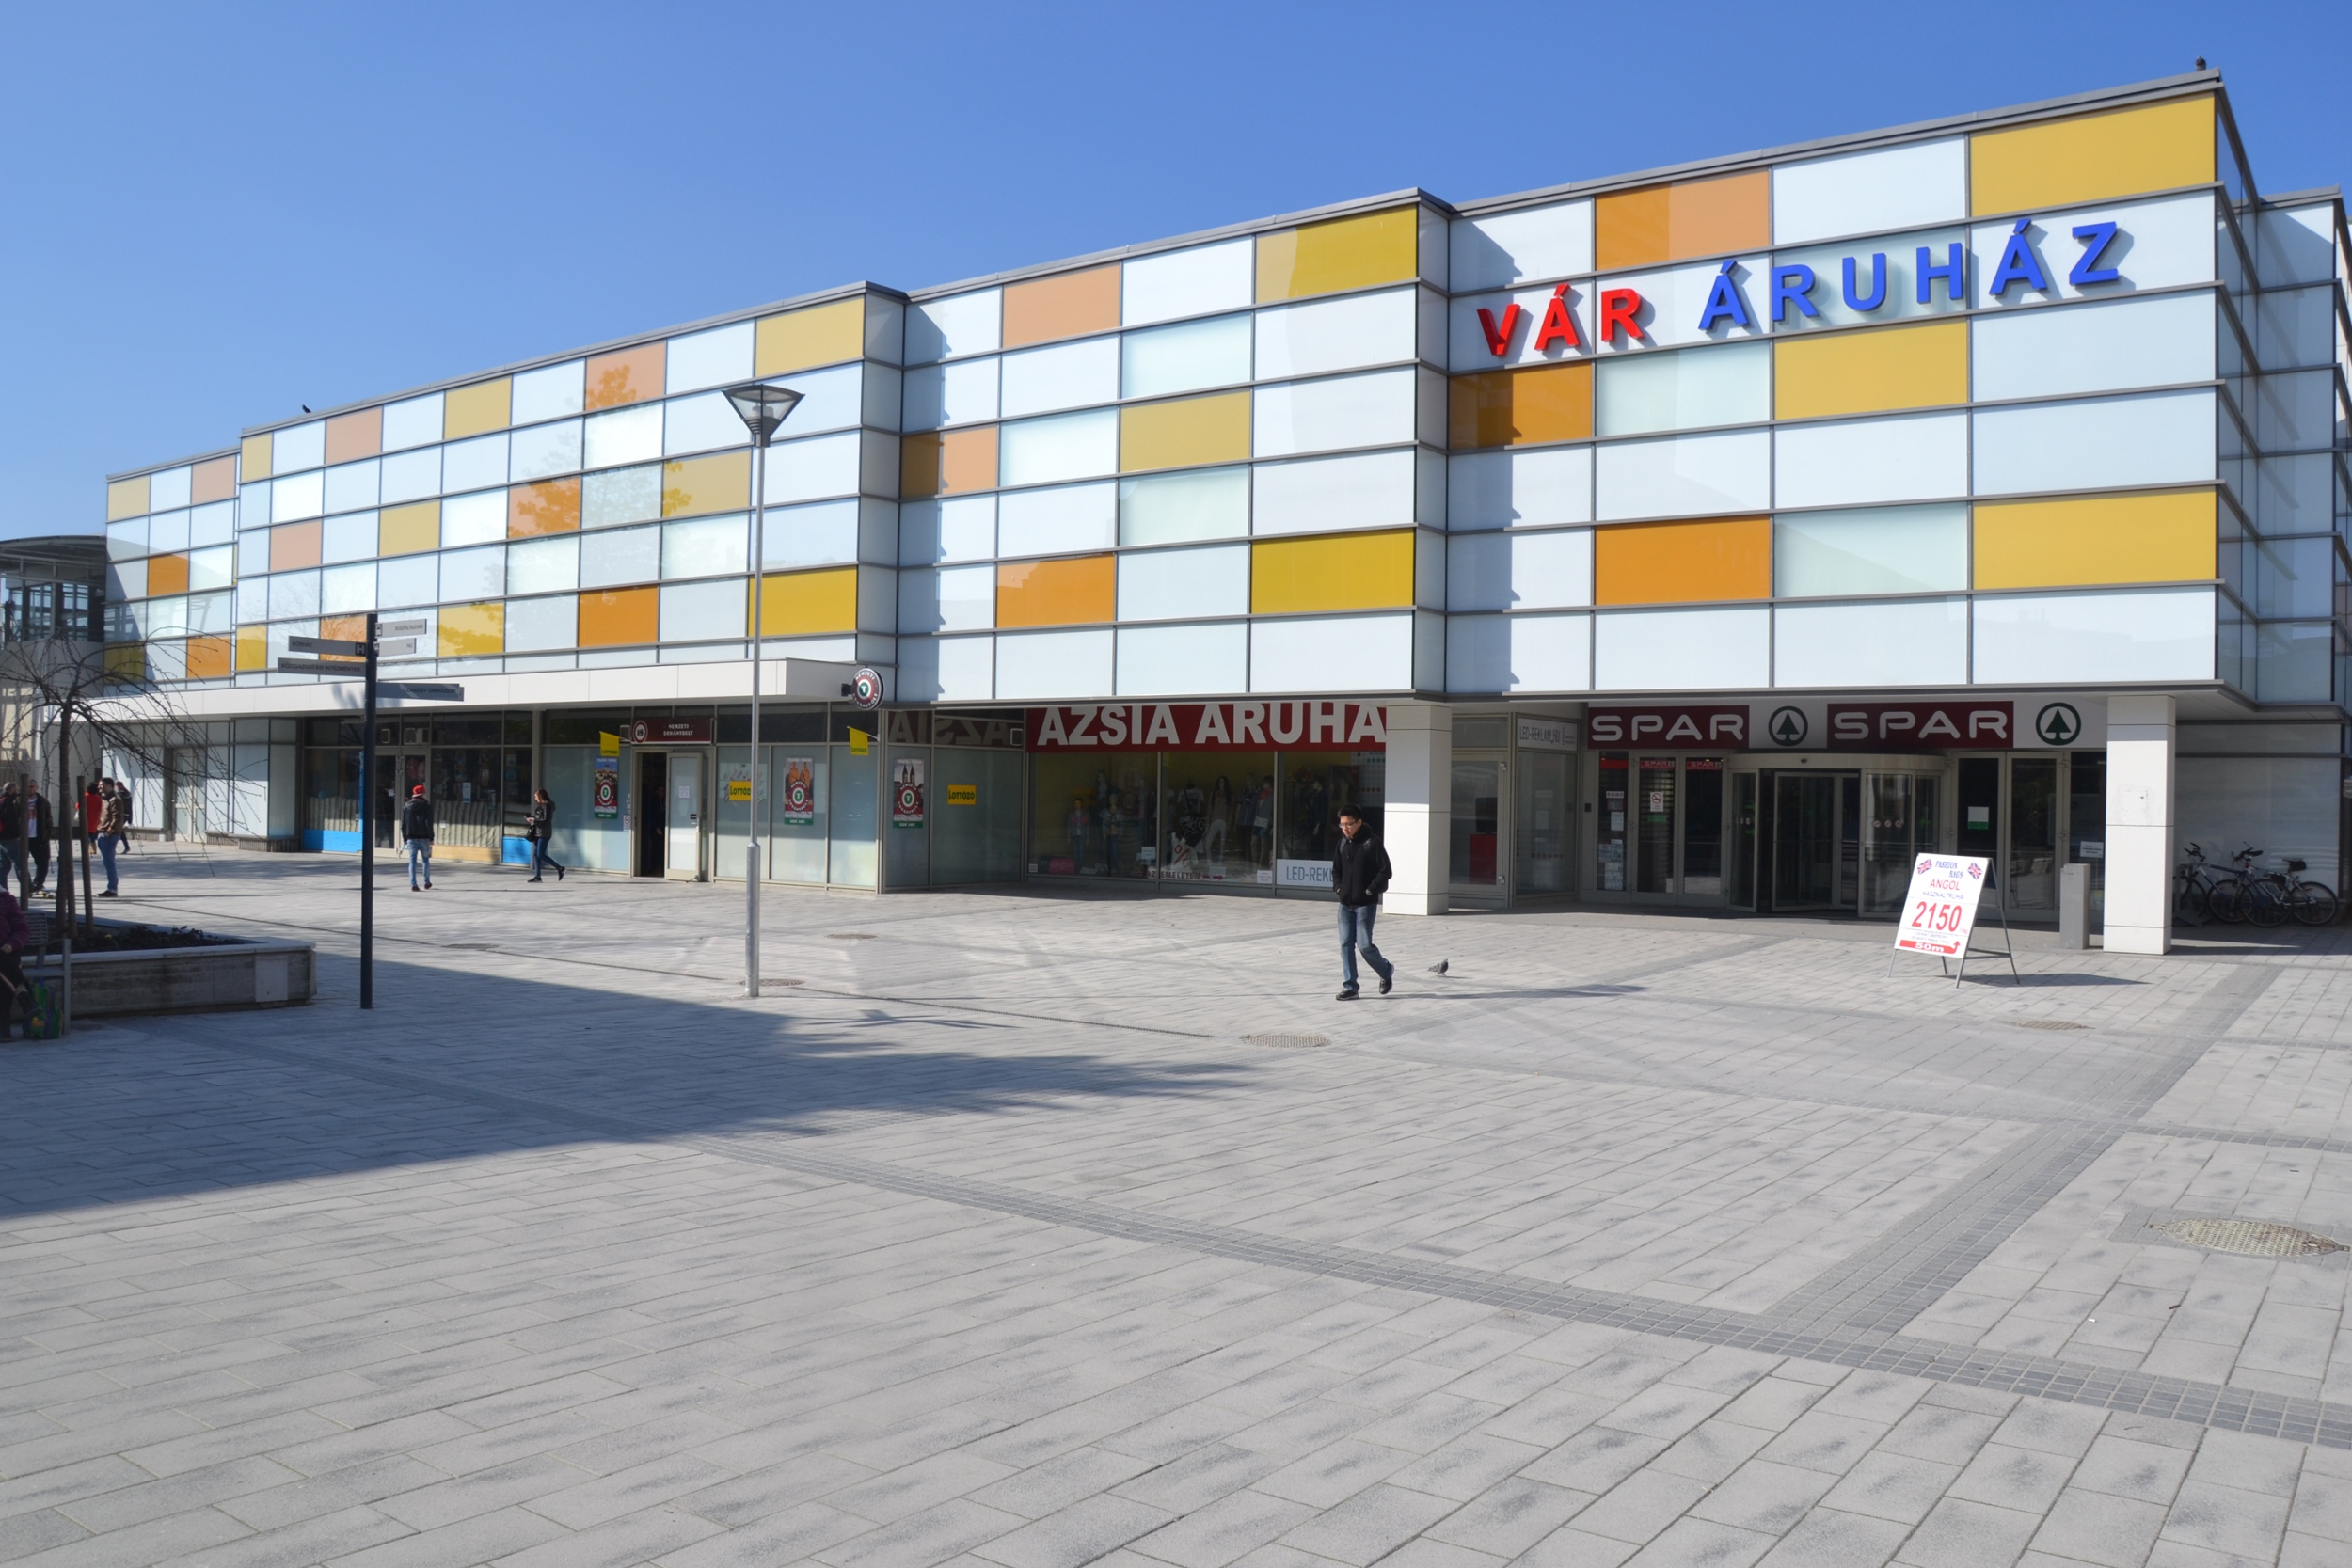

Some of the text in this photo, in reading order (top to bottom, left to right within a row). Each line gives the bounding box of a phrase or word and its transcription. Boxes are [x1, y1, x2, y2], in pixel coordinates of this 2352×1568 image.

[1477, 217, 2120, 356] VÁR ÁRUHÁZ
[1591, 713, 1744, 742] SPAR
[1832, 709, 2009, 741] SPAR
[1935, 860, 1959, 869] FASHION
[1929, 879, 1961, 891] ANGOL
[1911, 900, 1963, 932] 2150
[1915, 942, 1945, 953] 50m
